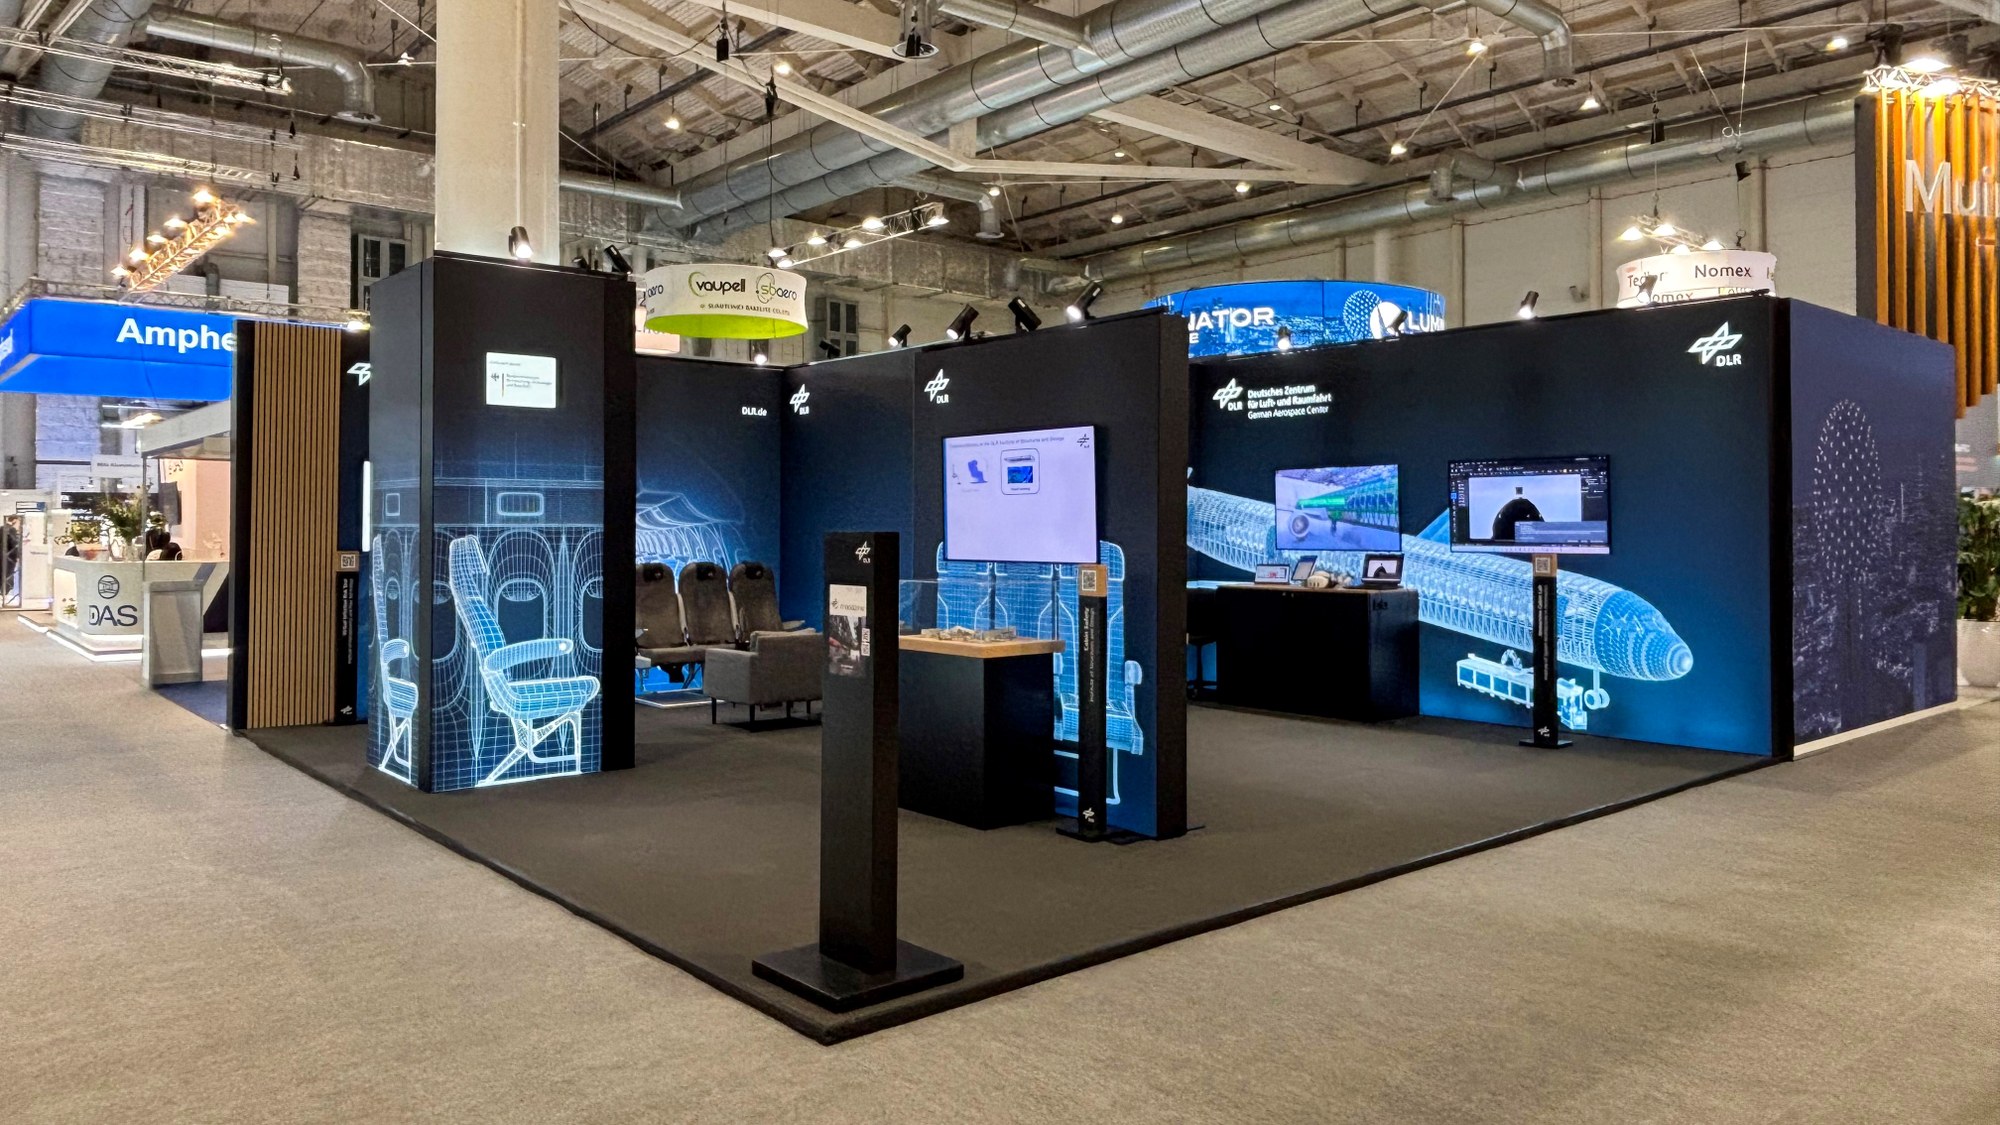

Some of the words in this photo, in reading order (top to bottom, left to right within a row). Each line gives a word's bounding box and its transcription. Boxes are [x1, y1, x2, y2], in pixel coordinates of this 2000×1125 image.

[1905, 160, 2000, 217] Mui
[1695, 264, 1751, 279] Nomex
[1628, 271, 1664, 288] Tedr
[696, 279, 745, 295] vaupell
[1650, 292, 1693, 303] omex
[1716, 354, 1742, 366] DLR
[937, 394, 949, 404] DLR
[1248, 387, 1283, 399] Deutsches
[1284, 385, 1316, 395] Zentrum
[1228, 401, 1243, 411] DLR
[1277, 396, 1291, 406] und
[1292, 393, 1332, 405] Raumfahrt
[1248, 411, 1272, 420] German
[1273, 408, 1305, 418] Aerospace
[1306, 406, 1329, 415] Center
[89, 605, 138, 626] DAS
